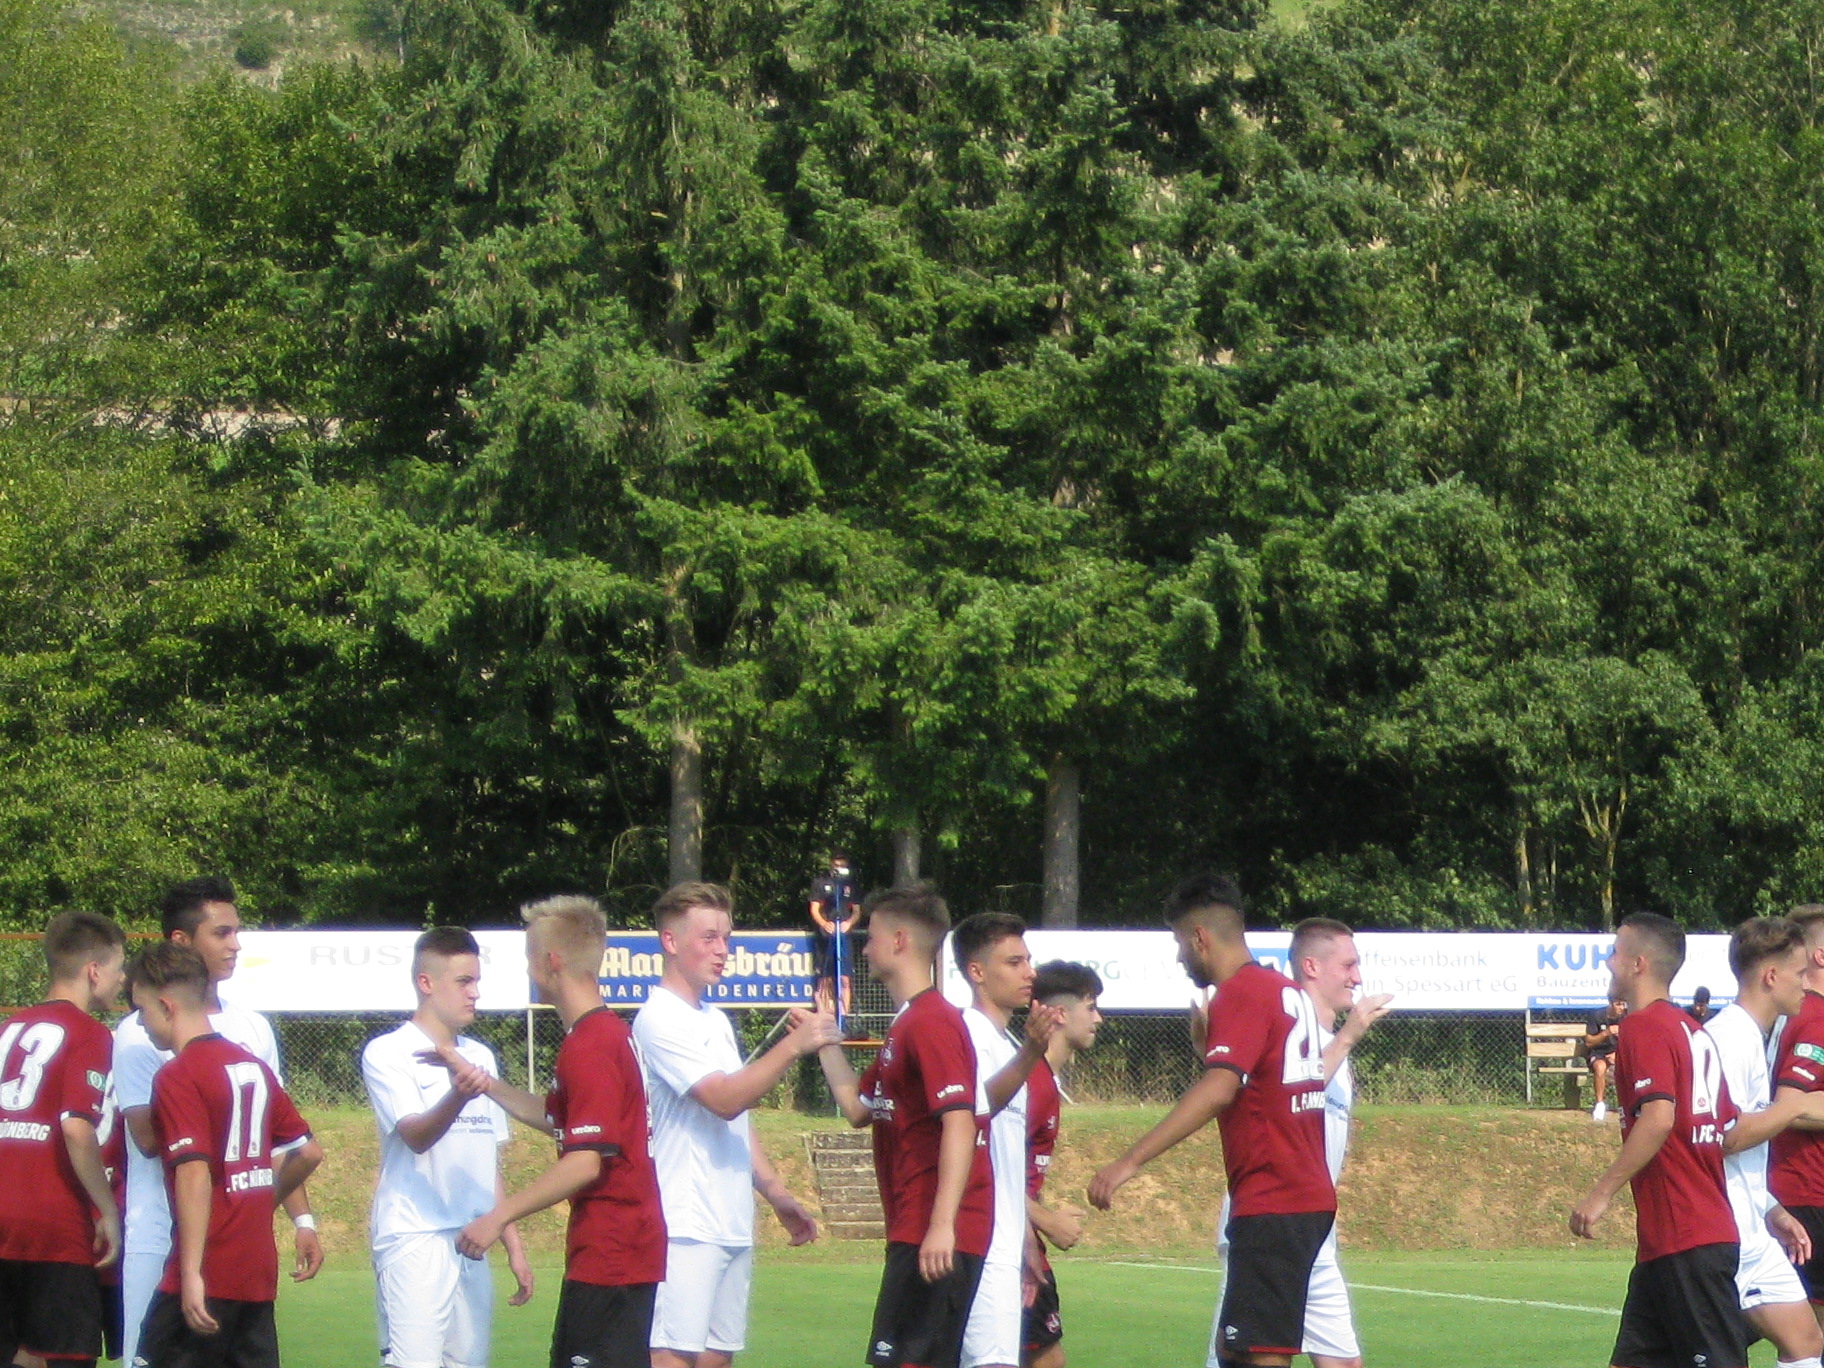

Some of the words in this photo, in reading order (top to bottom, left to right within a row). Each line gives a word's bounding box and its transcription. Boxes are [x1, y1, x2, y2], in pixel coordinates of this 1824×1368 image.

[1357, 950, 1488, 967] iffeisenbank
[1537, 944, 1616, 971] KUH
[1537, 976, 1608, 988] Bauzent
[599, 984, 814, 998] MARIDENFELD
[224, 1061, 268, 1162] 17
